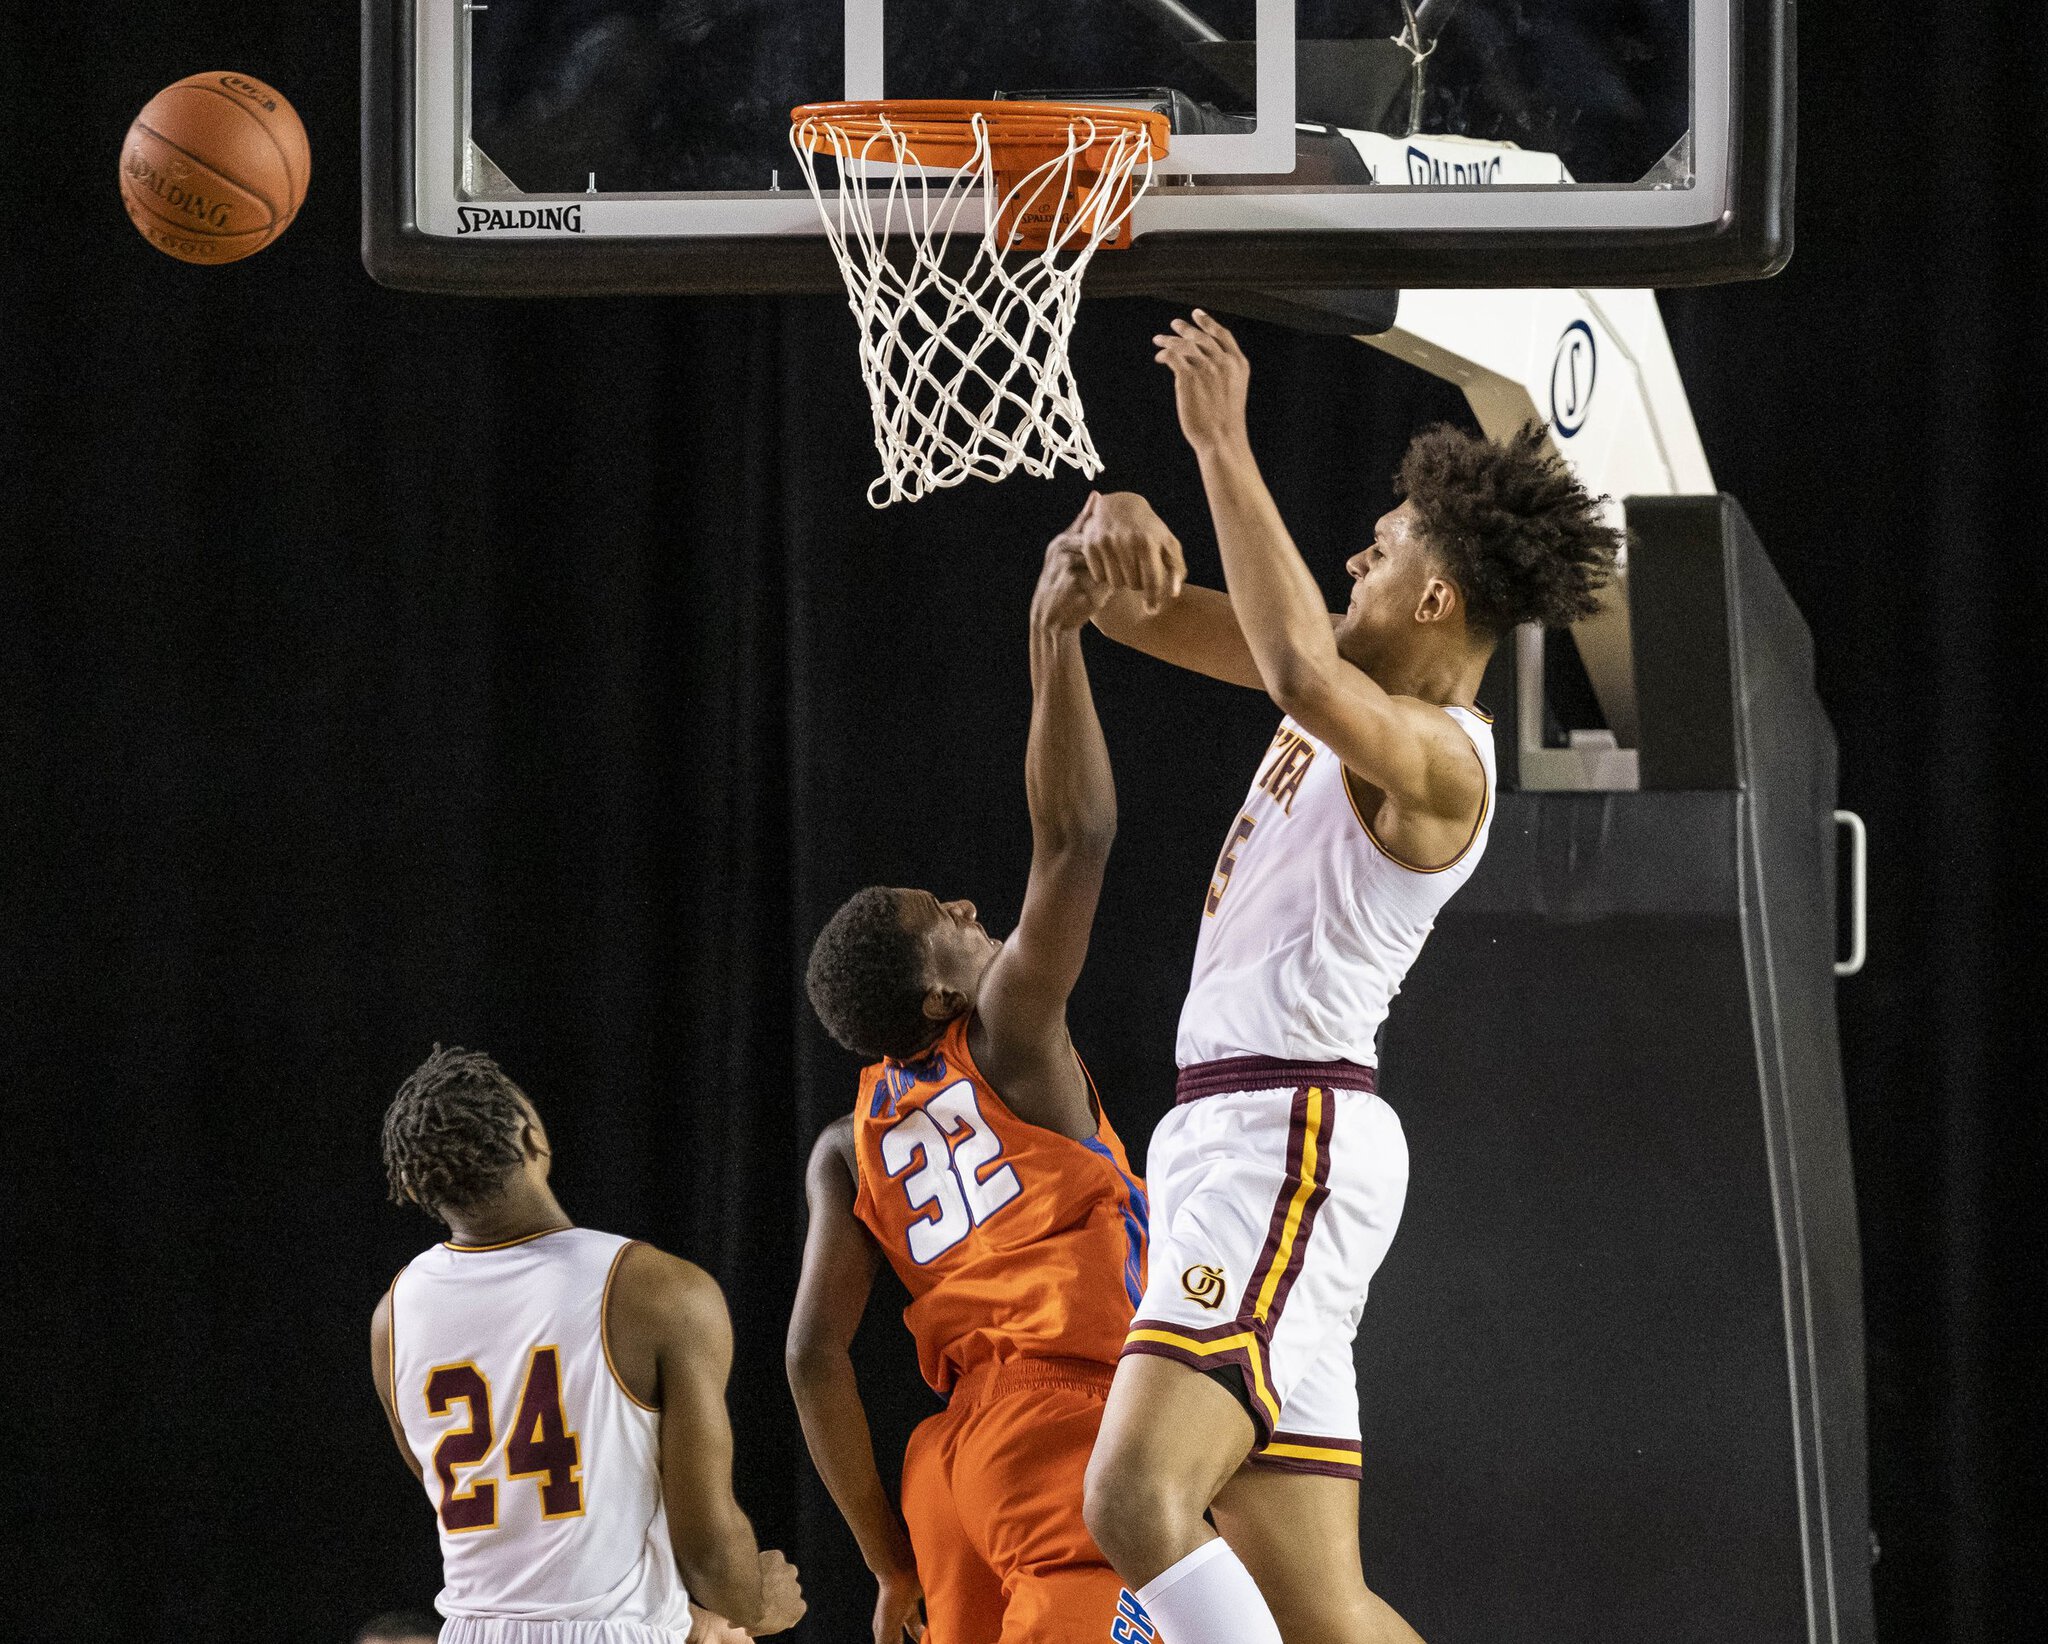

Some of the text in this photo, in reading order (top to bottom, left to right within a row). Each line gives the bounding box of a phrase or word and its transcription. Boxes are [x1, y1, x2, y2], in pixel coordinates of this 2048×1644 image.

[457, 204, 581, 234] SPALDING
[880, 1077, 1024, 1266] 32
[423, 1344, 587, 1534] 24
